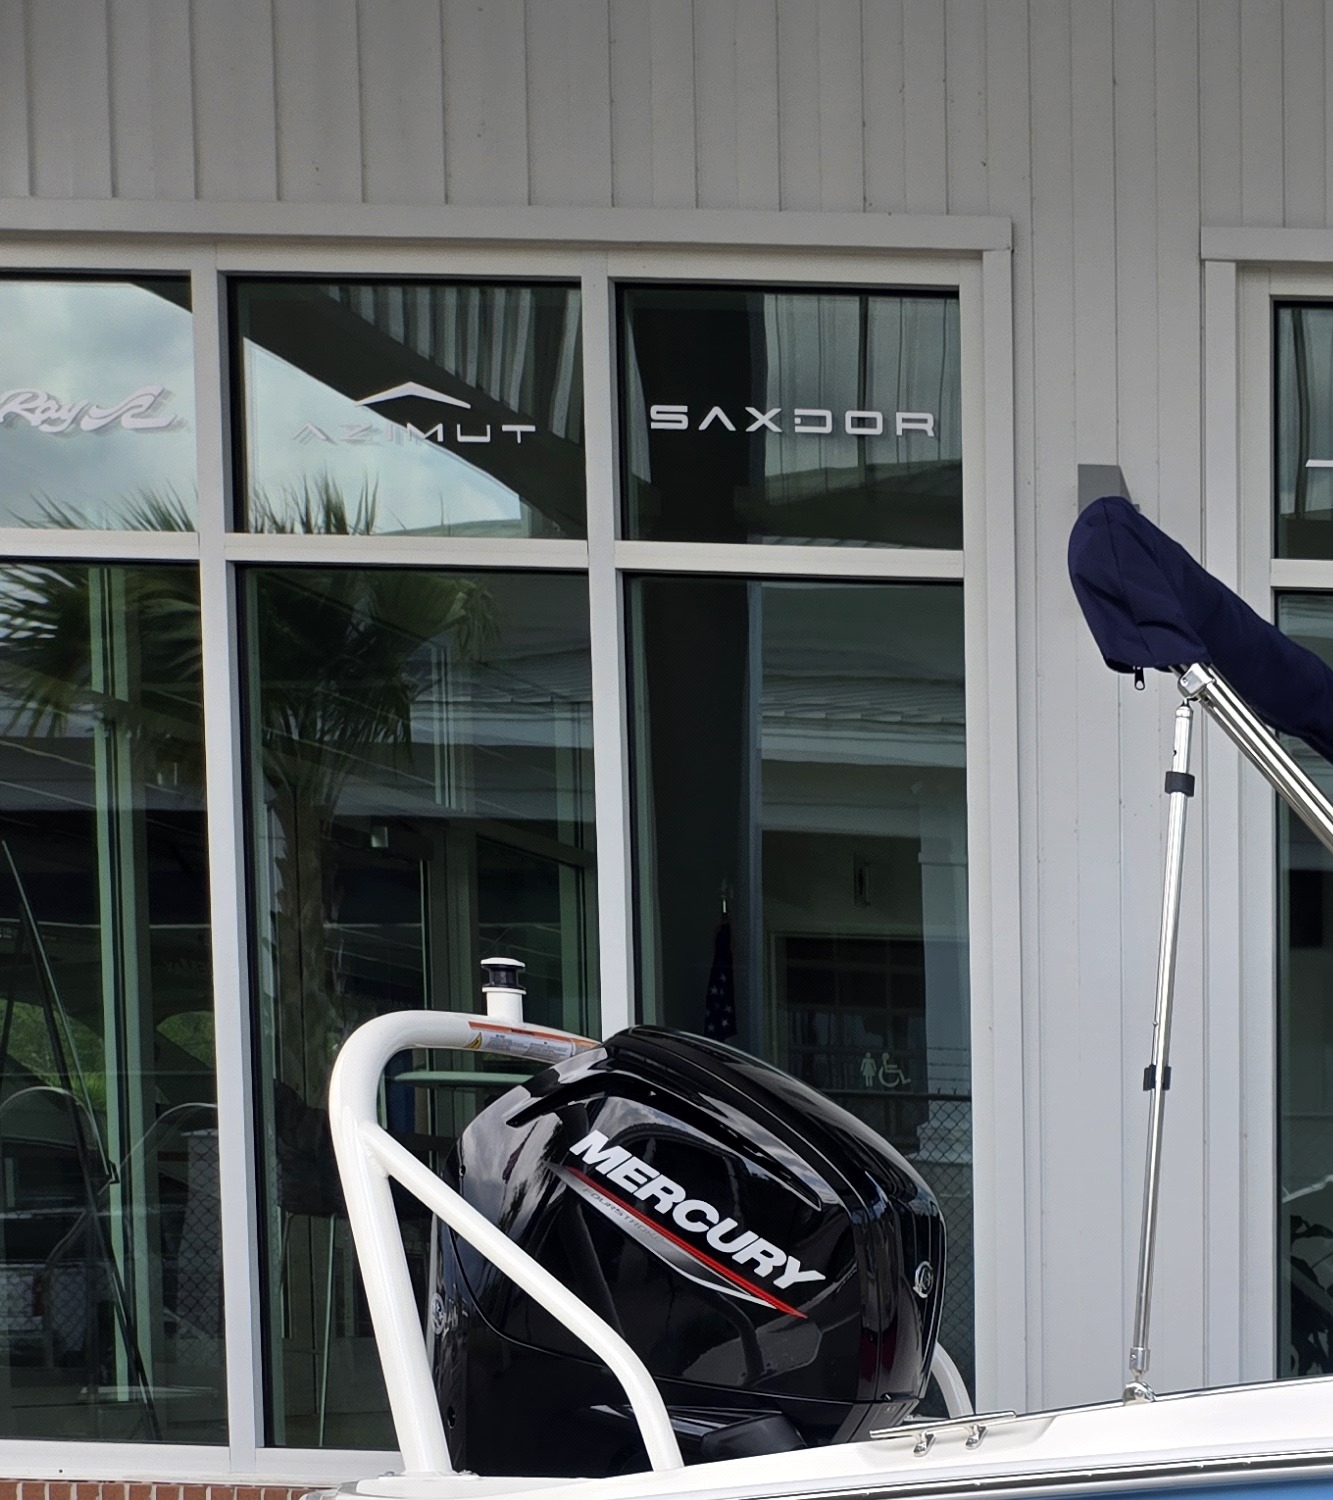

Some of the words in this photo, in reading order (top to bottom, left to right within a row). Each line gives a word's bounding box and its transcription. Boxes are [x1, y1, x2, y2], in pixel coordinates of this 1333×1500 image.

[293, 422, 536, 446] AZIMUT
[650, 404, 935, 437] SAXDOR
[569, 1129, 826, 1289] MERCURY
